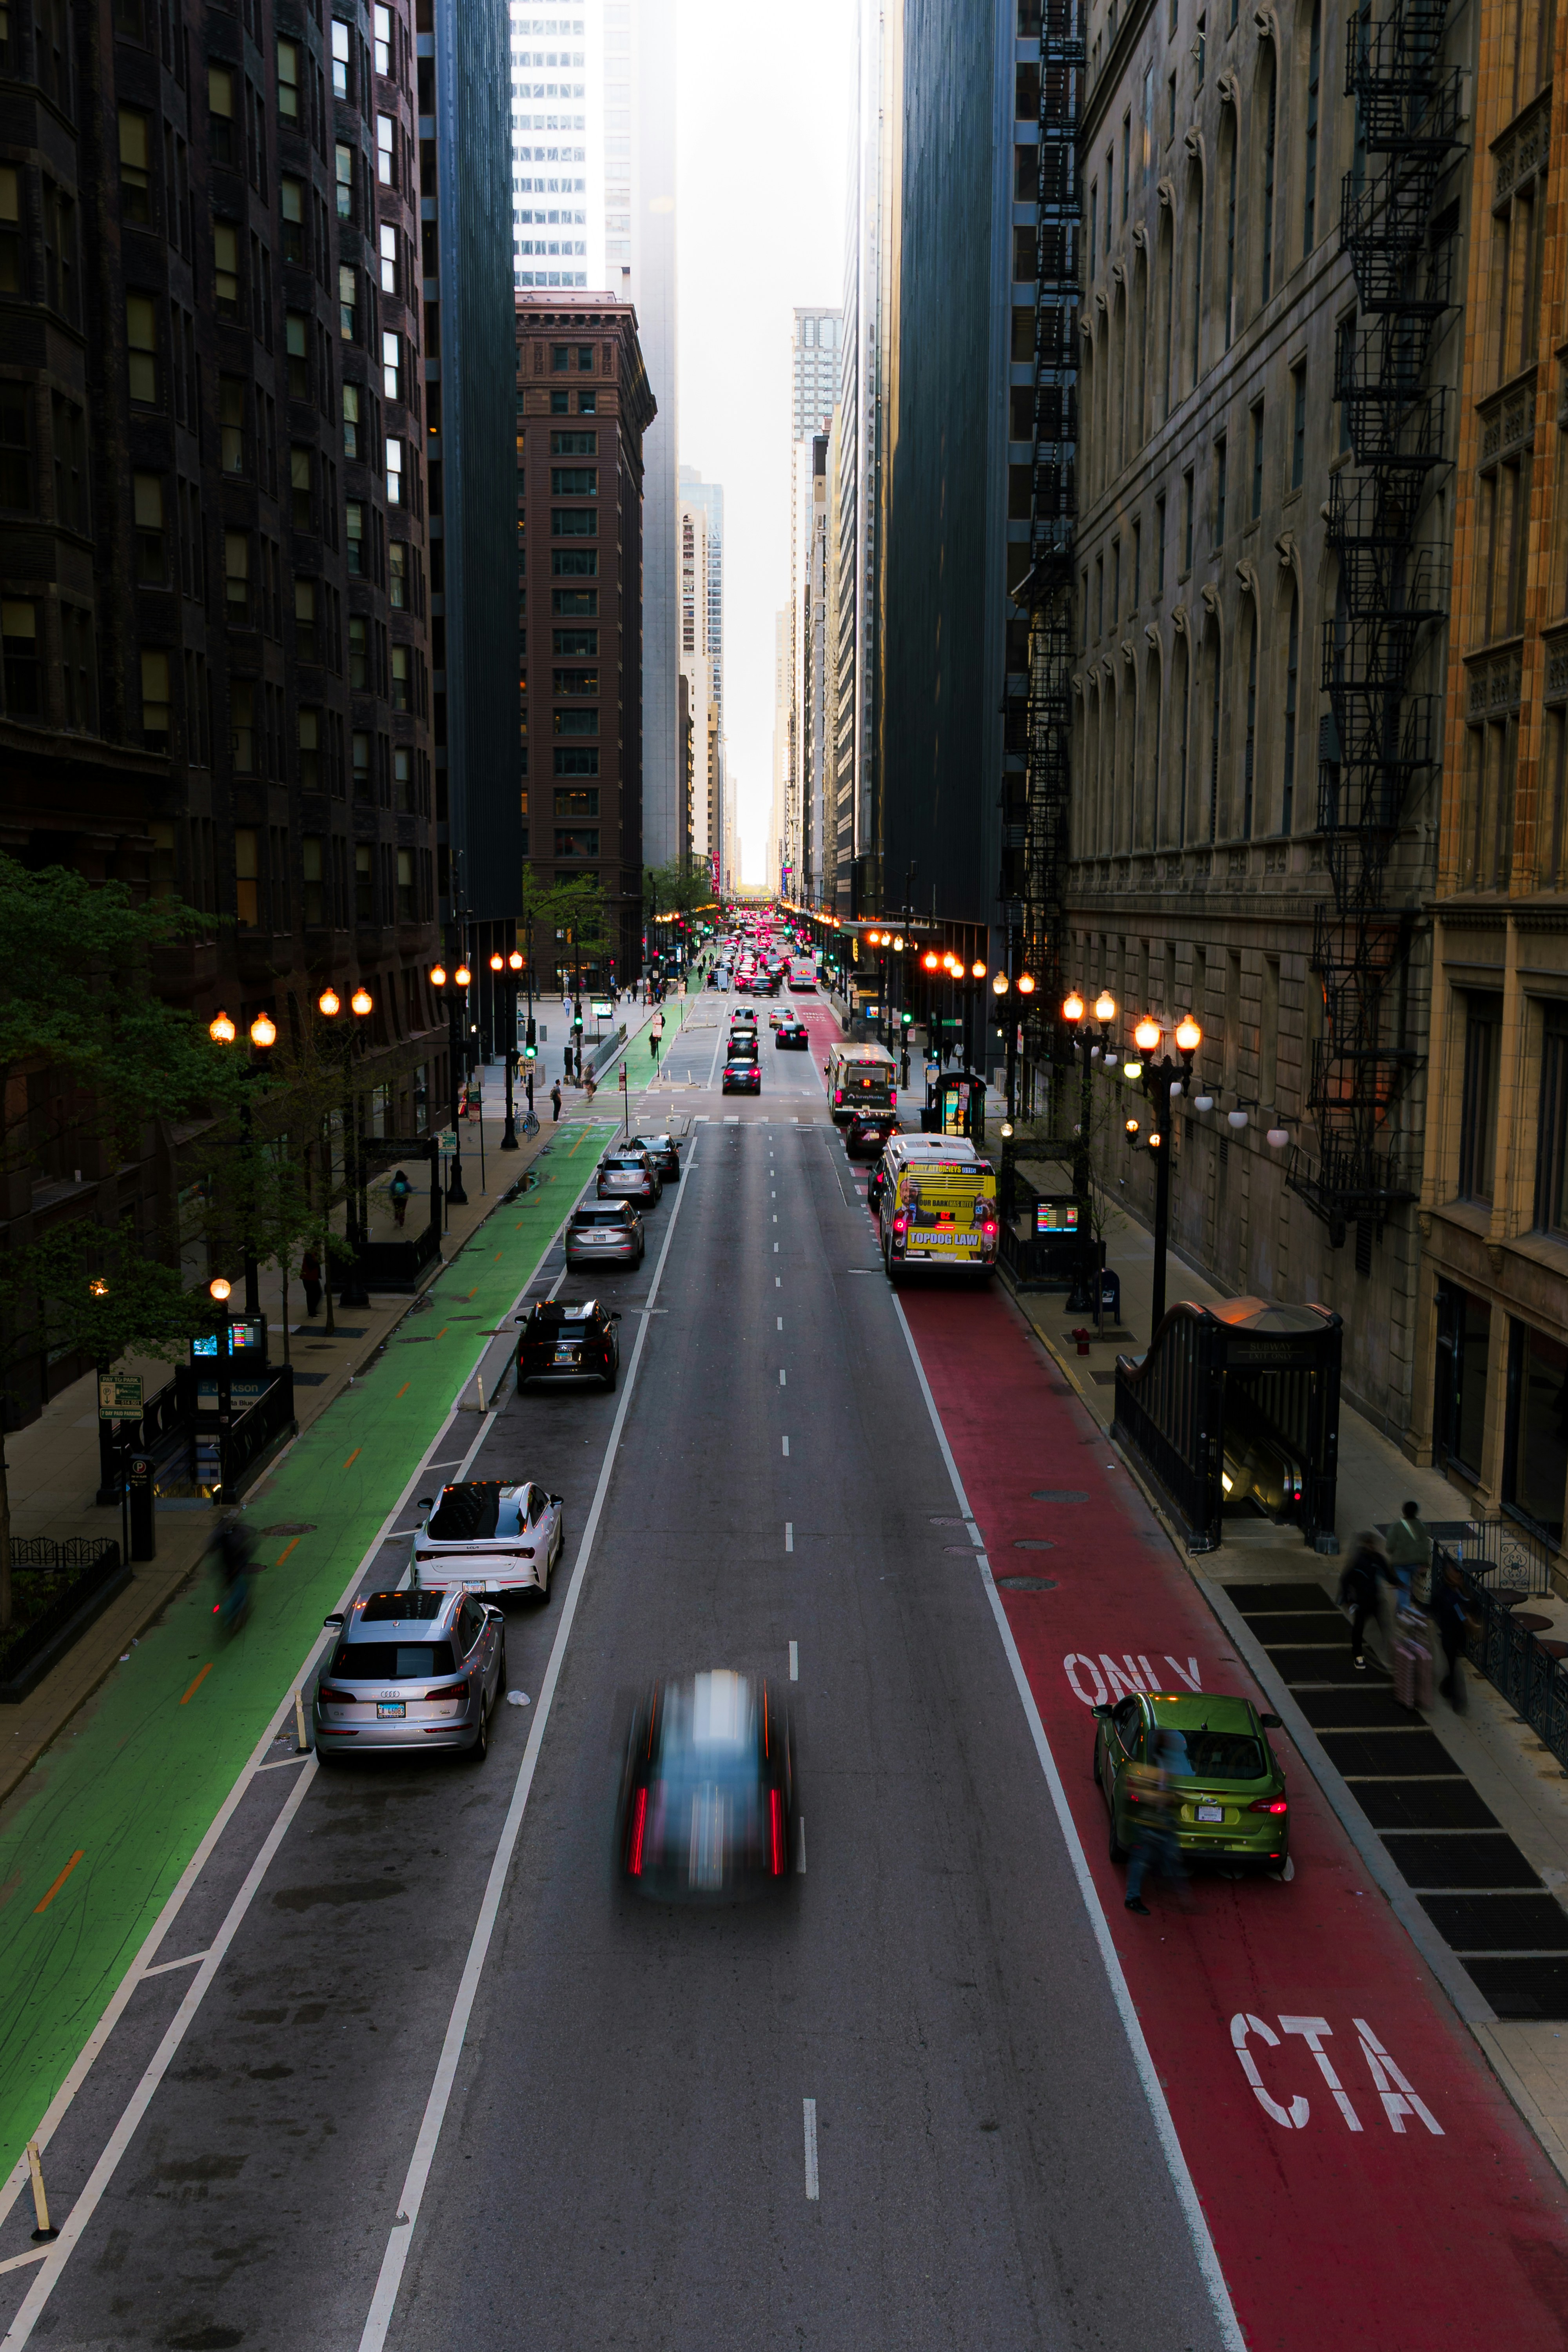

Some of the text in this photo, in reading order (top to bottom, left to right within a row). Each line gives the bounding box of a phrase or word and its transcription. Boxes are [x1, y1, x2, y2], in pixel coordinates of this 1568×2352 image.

[910, 1232, 978, 1246] TOPDOG LAW
[1250, 1343, 1293, 1351] SUBWAY
[212, 1382, 258, 1392] Jkson
[137, 1463, 143, 1472] P
[1063, 1653, 1203, 1706] ONLY
[1230, 2013, 1446, 2135] CTA
